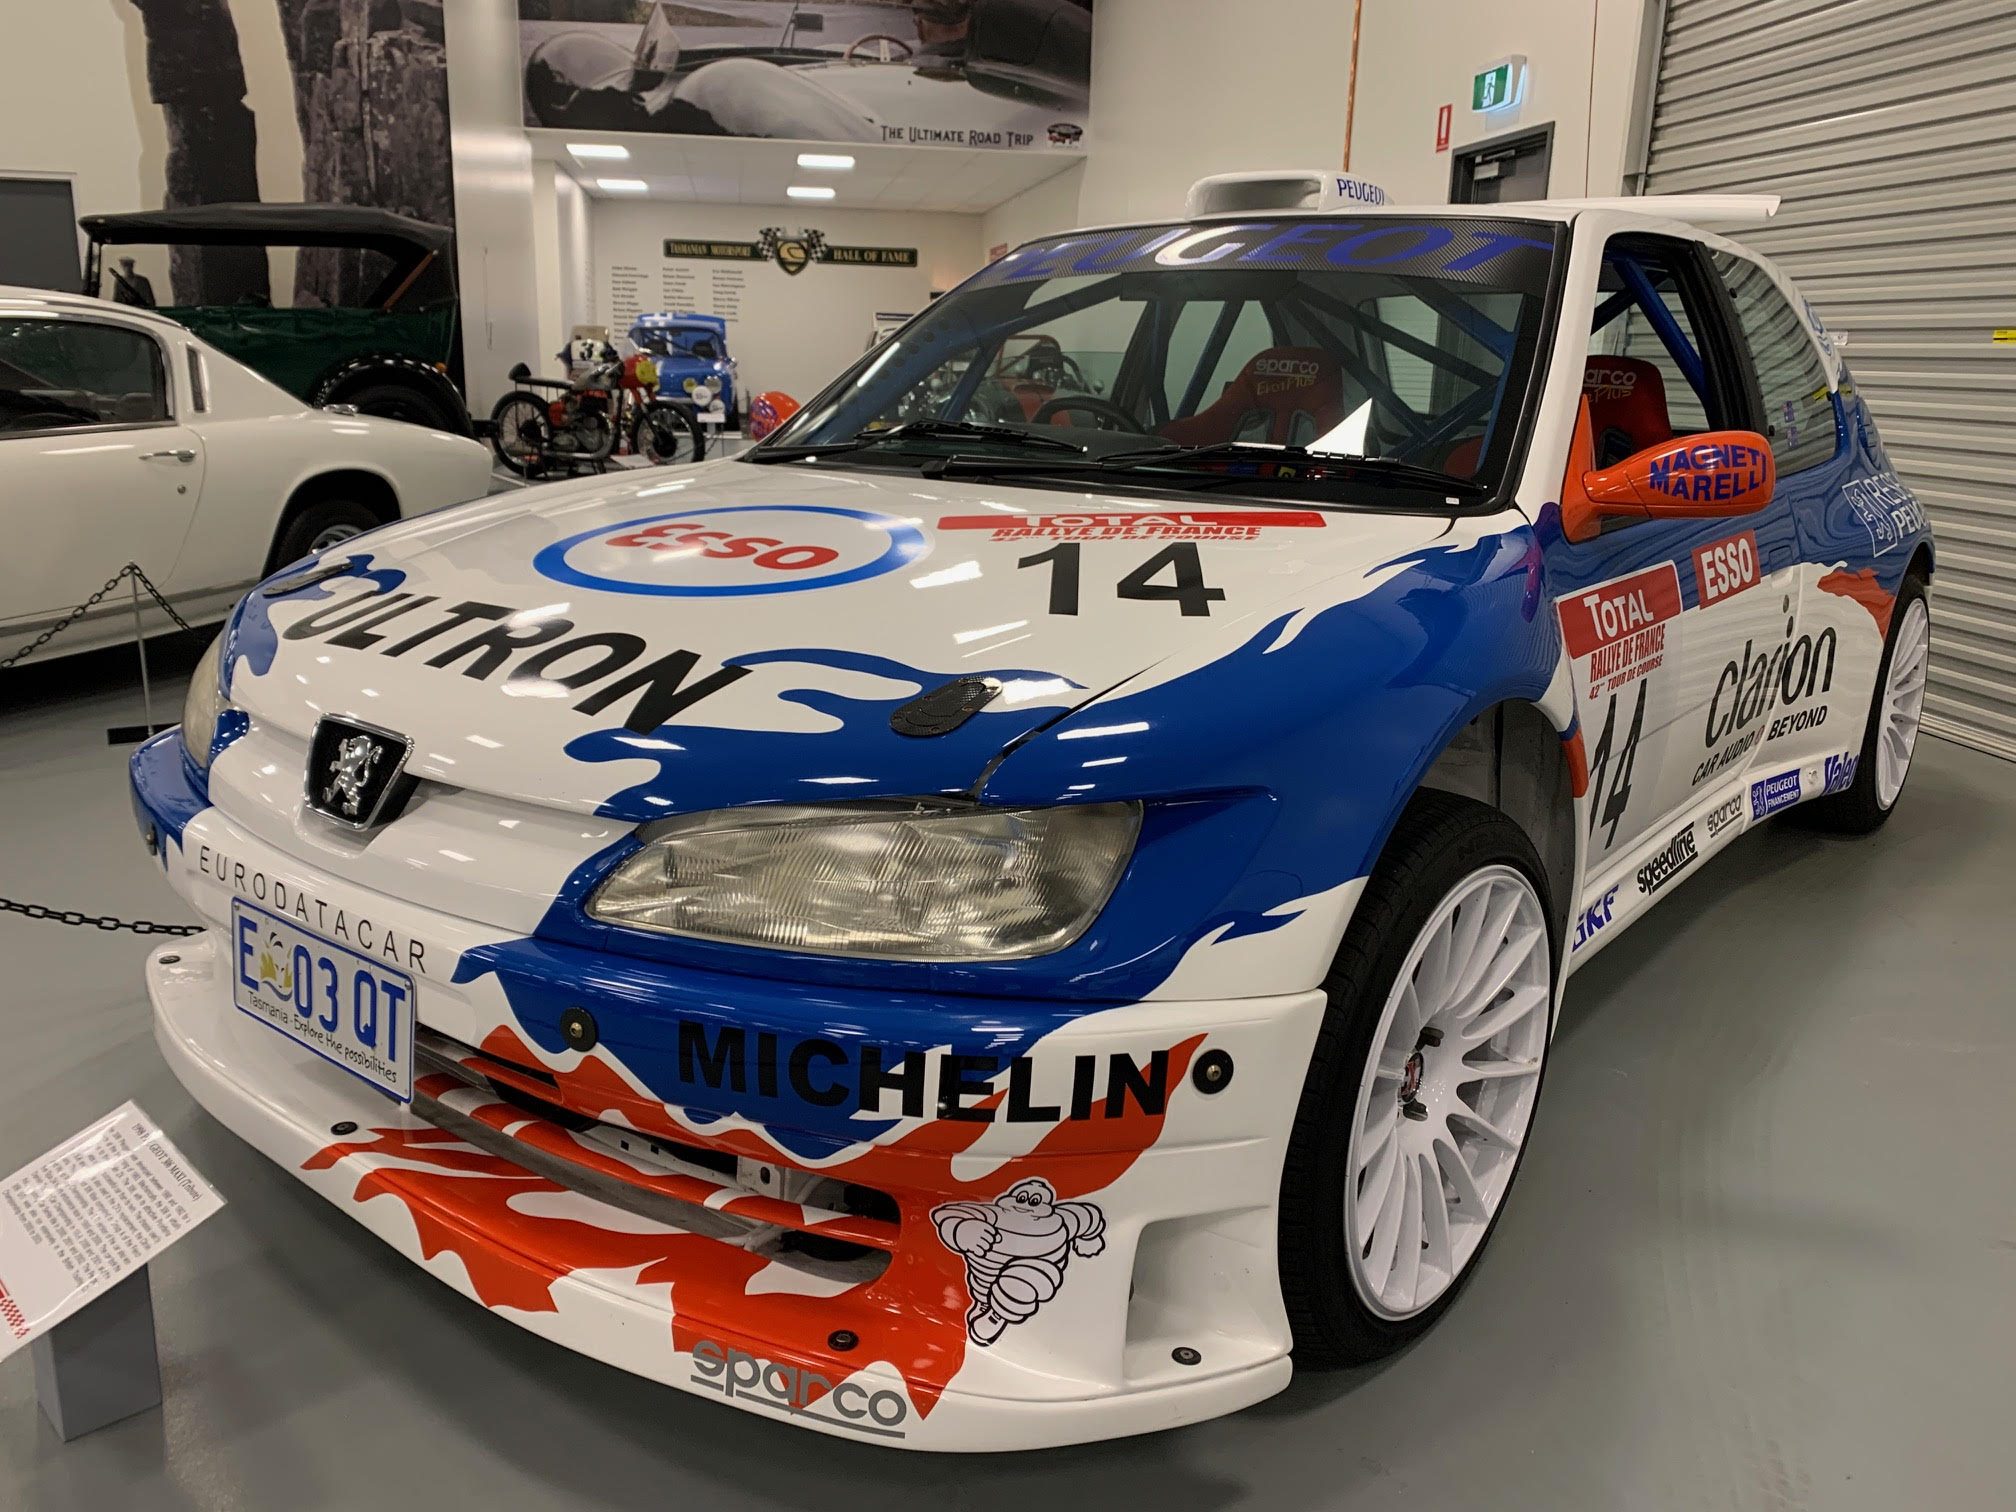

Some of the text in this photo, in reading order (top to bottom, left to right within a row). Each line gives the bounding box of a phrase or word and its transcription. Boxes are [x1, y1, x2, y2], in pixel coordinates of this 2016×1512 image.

[881, 125, 1034, 147] THE ULTIMATE ROAD TRIP
[1336, 178, 1384, 206] PEUGEOT
[833, 248, 911, 263] HALL OF FAME
[1255, 358, 1320, 375] sparco
[1585, 368, 1637, 386] arco
[1650, 444, 1767, 478] MAGNETI
[1650, 464, 1767, 501] MARELLI
[992, 526, 1262, 537] RALLYE DE FRANCE
[1013, 514, 1218, 527] TOTAL
[1018, 542, 1227, 617] 14
[1701, 537, 1753, 600] ESSO
[1583, 589, 1655, 641] TOTAL
[282, 591, 754, 736] ULTRON
[1590, 623, 1666, 683] RALLYE DE FRANCE
[1607, 672, 1627, 692] TOUR
[1626, 667, 1636, 682] DE
[1705, 616, 1837, 749] clarion
[1589, 677, 1647, 850] 14
[1692, 752, 1720, 787] CAR
[1716, 730, 1755, 770] AUDIO
[1766, 705, 1828, 741] BEYOND
[1766, 774, 1798, 796] PEUGEOT
[1767, 788, 1800, 809] FINANCEMENT
[1707, 794, 1742, 836] sparco
[1636, 828, 1698, 896] speedline
[199, 845, 427, 974] EURODATACAR
[238, 915, 406, 1063] E 03 QT
[247, 990, 289, 1024] Tasmania
[293, 1013, 324, 1044] Explore
[325, 1032, 343, 1055] the
[344, 1046, 397, 1083] possibilities
[677, 1019, 1170, 1123] MICHELIN
[140, 1132, 168, 1161] PGEOT
[690, 1340, 907, 1427] sparco
